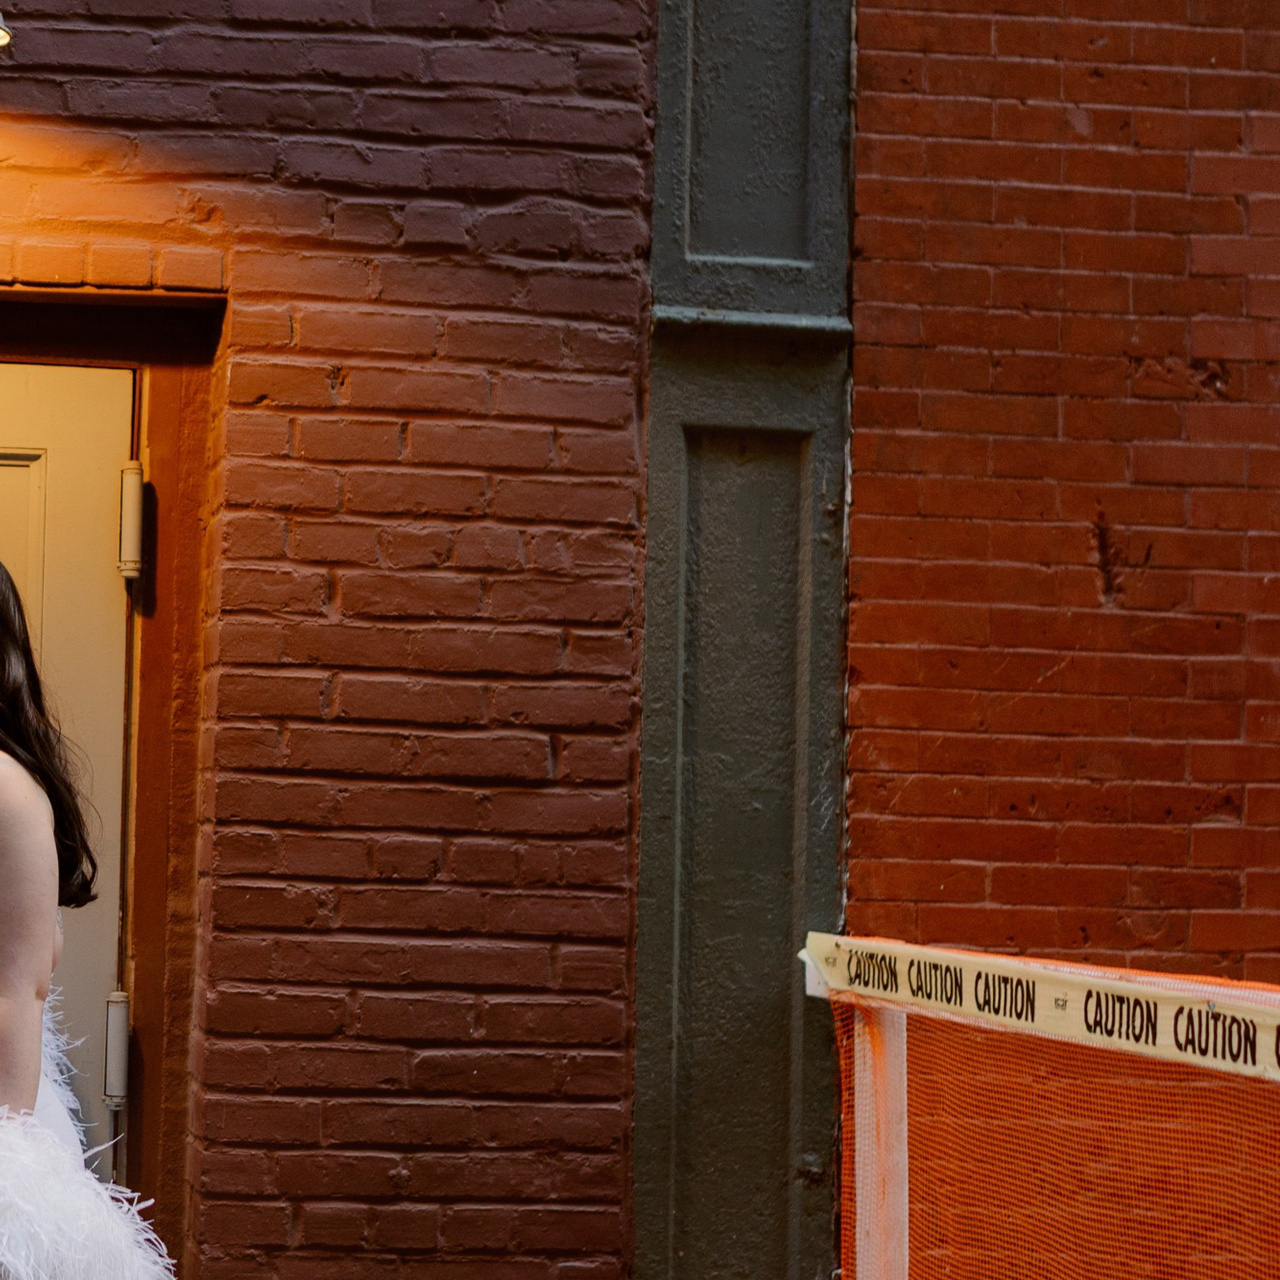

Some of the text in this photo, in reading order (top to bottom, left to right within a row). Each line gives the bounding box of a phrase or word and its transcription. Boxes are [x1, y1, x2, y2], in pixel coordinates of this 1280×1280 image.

[846, 949, 899, 993] CAUTION
[907, 958, 963, 1007] CAUTION
[974, 970, 1036, 1023] CAUTION
[1083, 988, 1158, 1047] CAUTION
[1173, 1005, 1258, 1066] CAUTION
